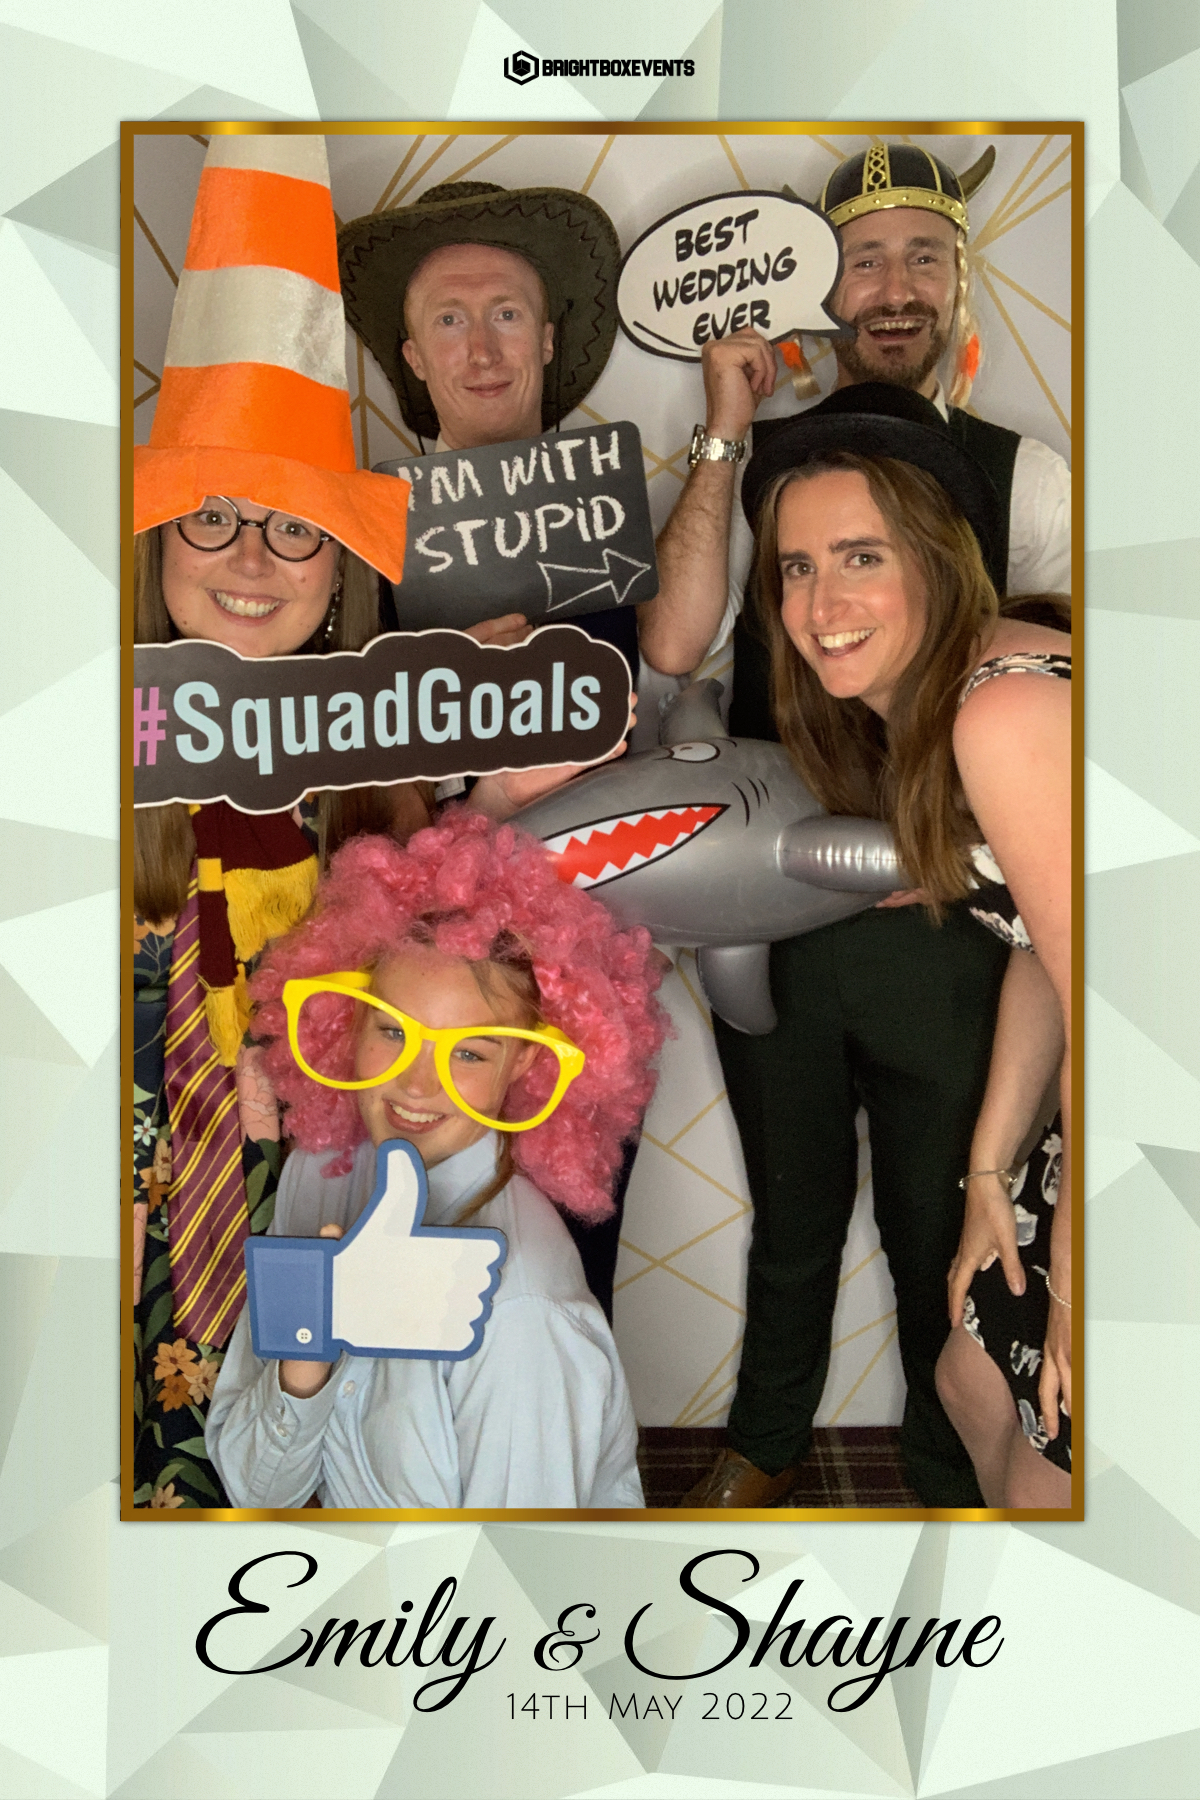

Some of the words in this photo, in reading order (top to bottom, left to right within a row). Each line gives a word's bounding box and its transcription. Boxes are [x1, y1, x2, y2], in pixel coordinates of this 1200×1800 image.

[675, 209, 759, 262] BEST
[653, 246, 797, 312] WEDDING
[692, 299, 771, 345] EVER
[397, 458, 484, 512] I'M
[133, 662, 601, 775] #SquadGoals
